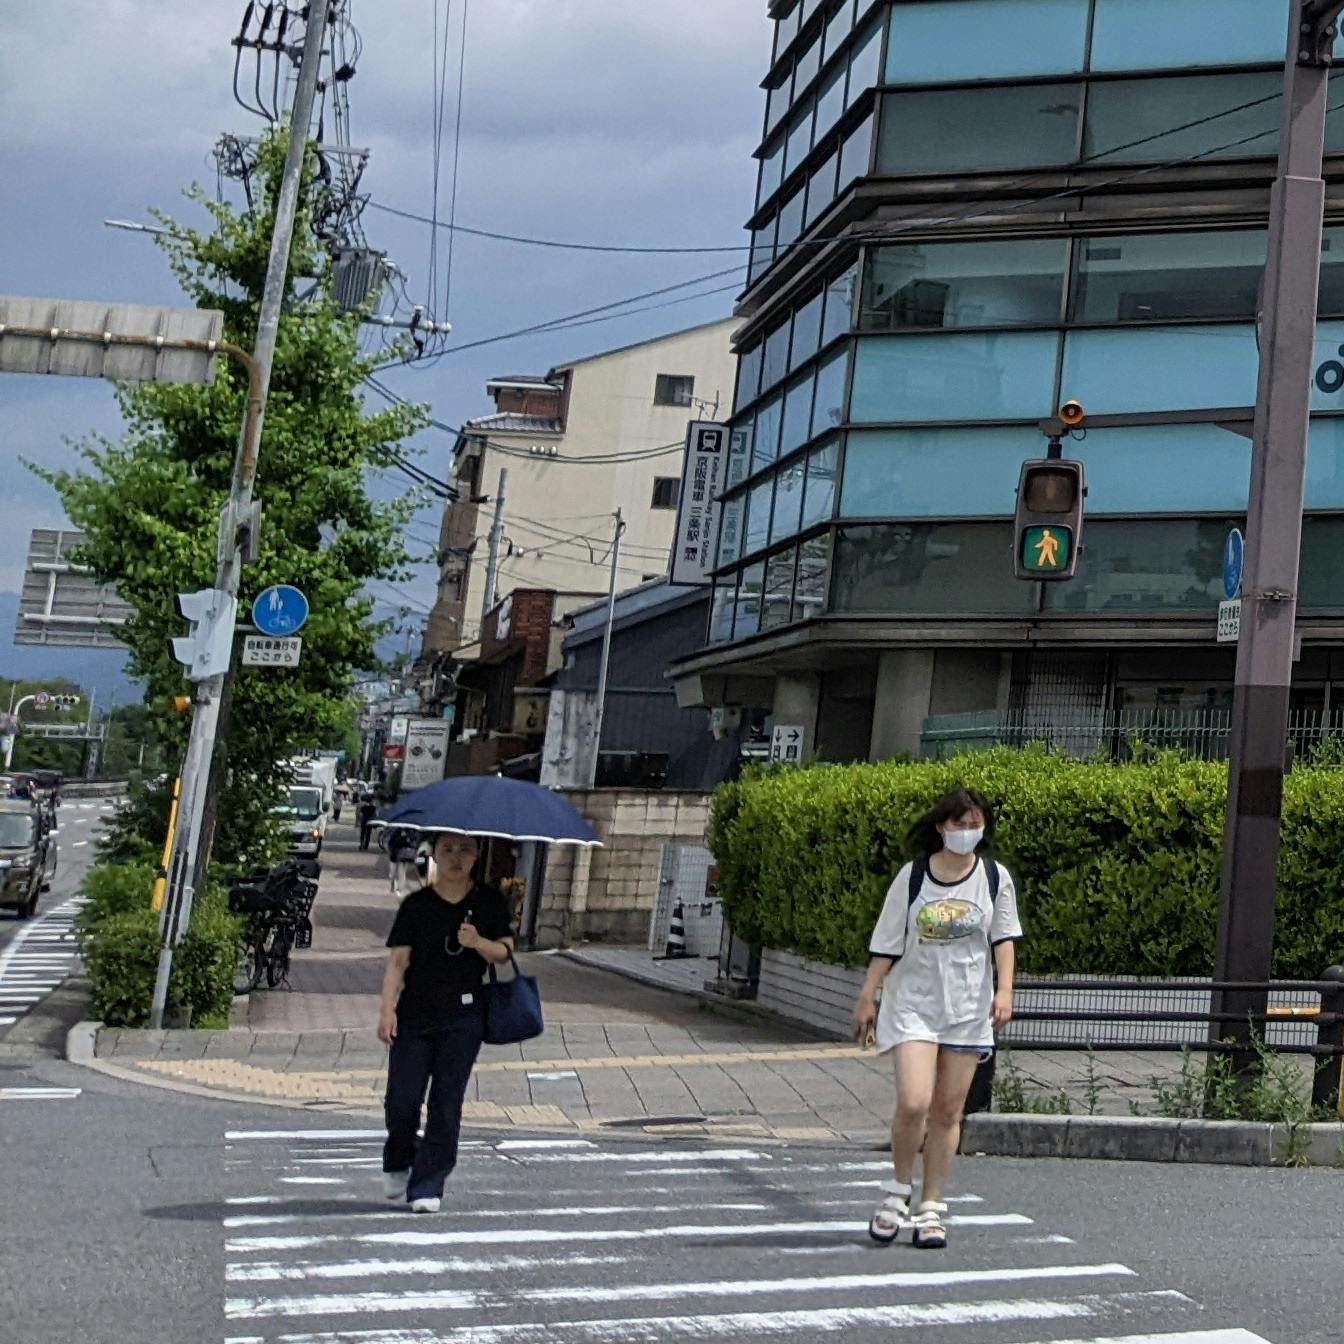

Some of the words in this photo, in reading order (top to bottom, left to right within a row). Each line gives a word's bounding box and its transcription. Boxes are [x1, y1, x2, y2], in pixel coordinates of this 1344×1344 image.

[692, 456, 709, 502] 京阪電車
[686, 506, 703, 542] 三条駅
[250, 651, 293, 662] ここから
